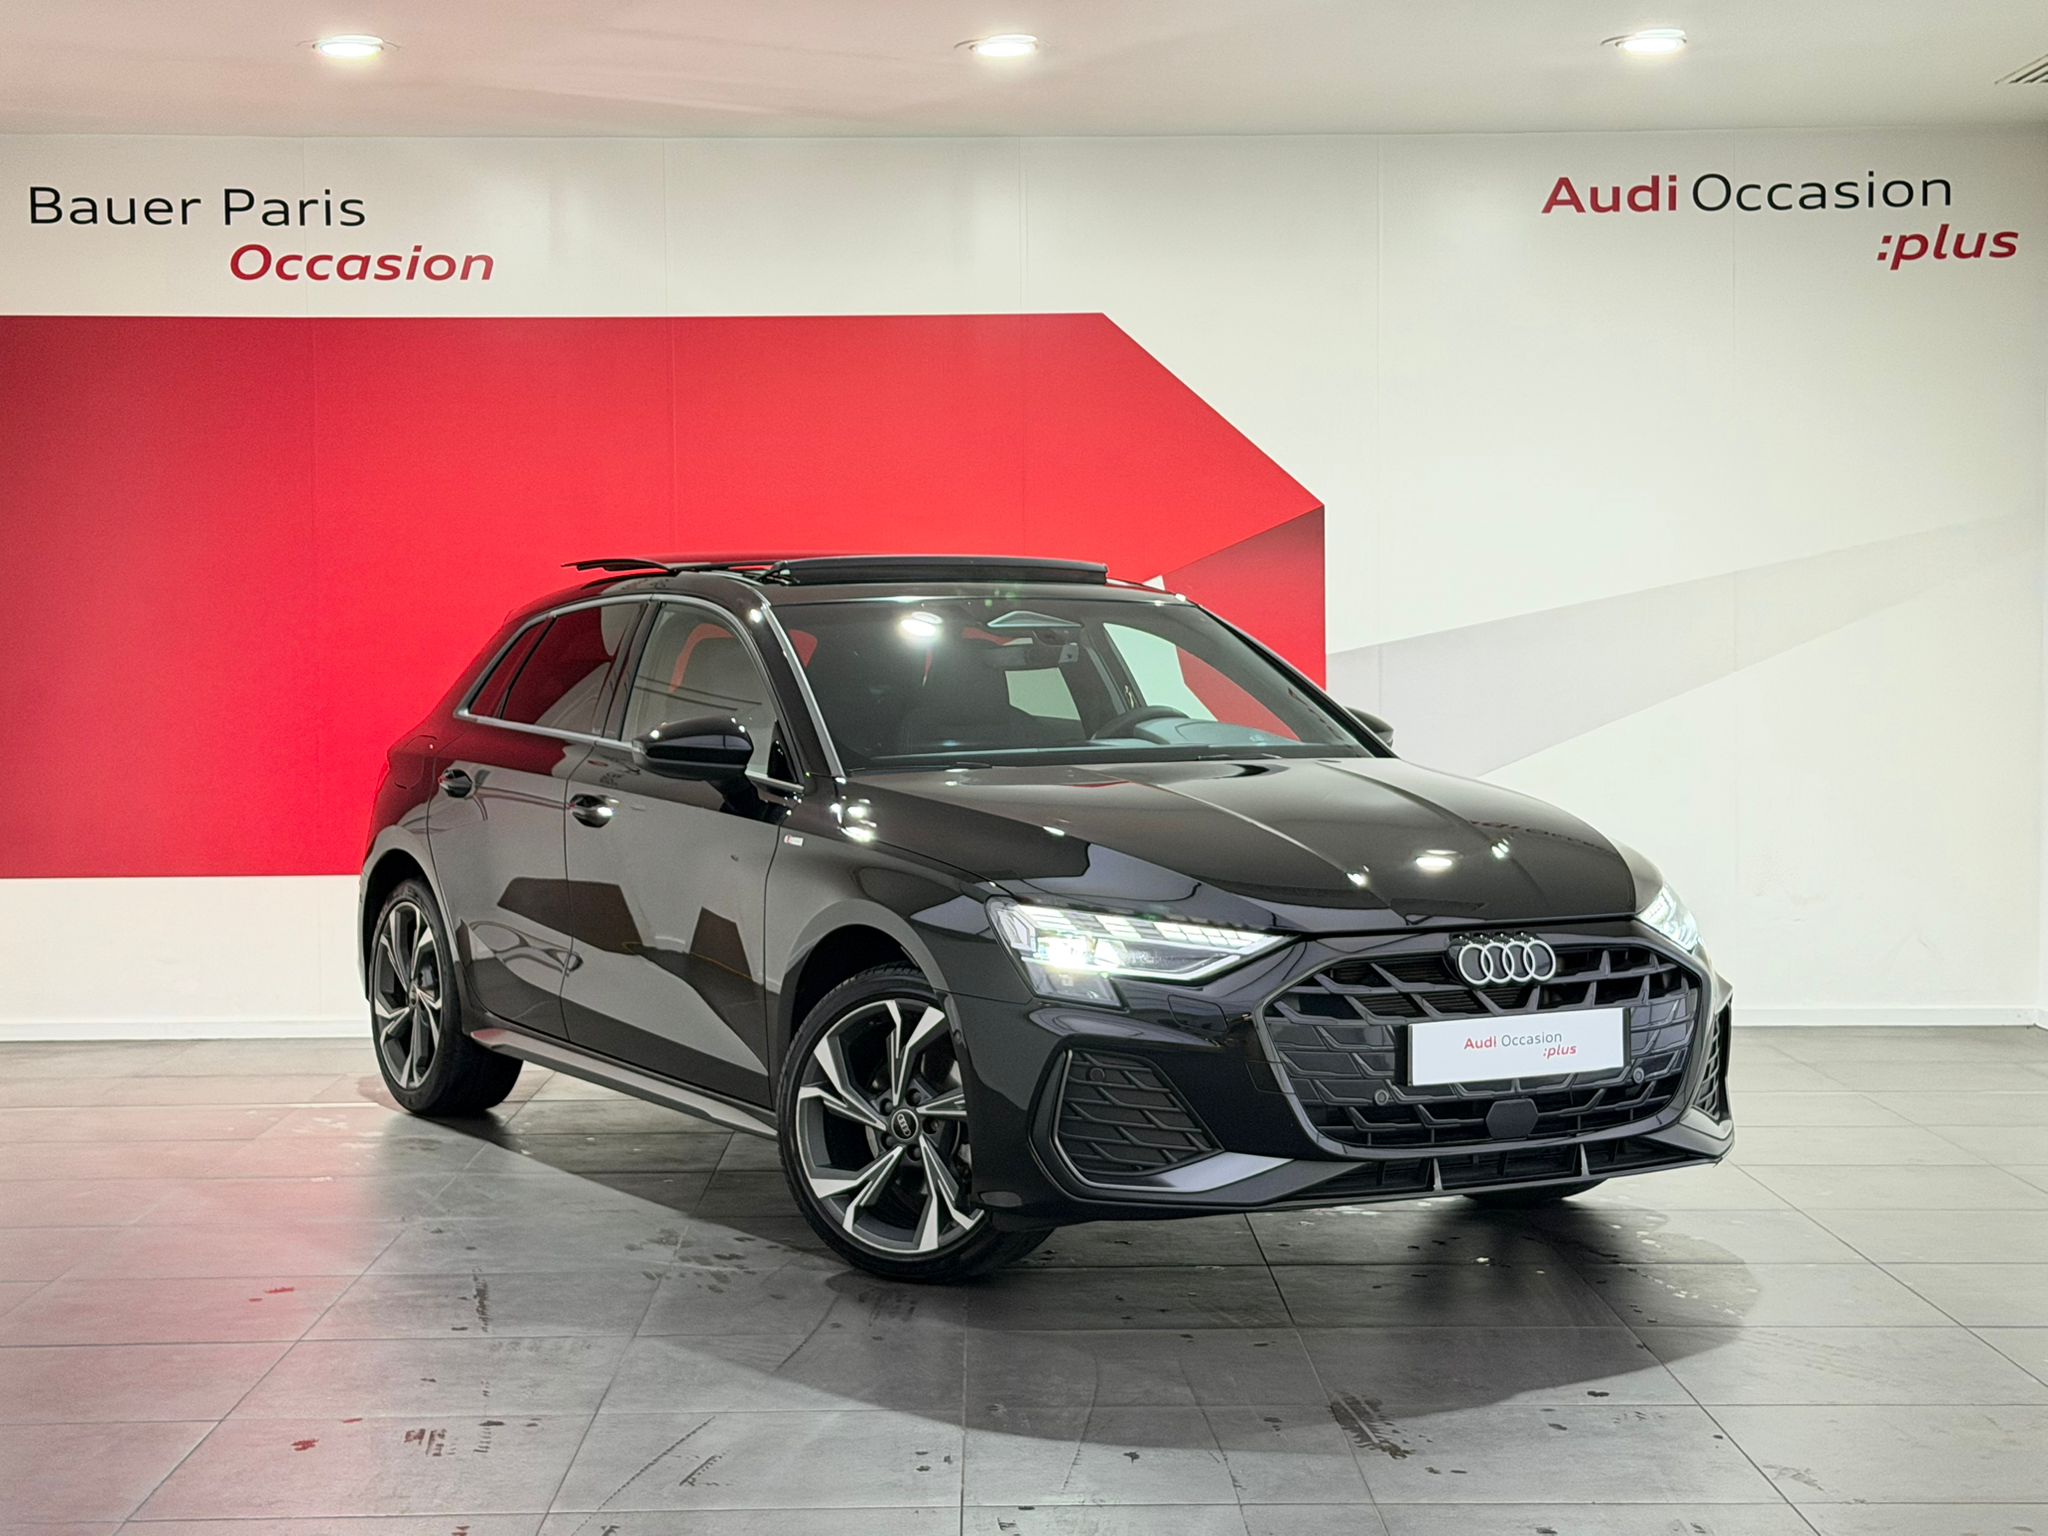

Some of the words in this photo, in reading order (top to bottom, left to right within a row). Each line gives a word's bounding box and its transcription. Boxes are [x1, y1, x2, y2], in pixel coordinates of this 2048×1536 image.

[29, 186, 202, 226] Bauer
[223, 188, 366, 227] Paris
[1541, 174, 1678, 214] Audi
[1692, 170, 1952, 212] Occasion
[229, 243, 494, 282] Occasion
[1876, 223, 2020, 271] :plus
[1464, 1036, 1497, 1050] Audi
[1501, 1031, 1562, 1047] Occasion
[1543, 1044, 1577, 1059] :plus
